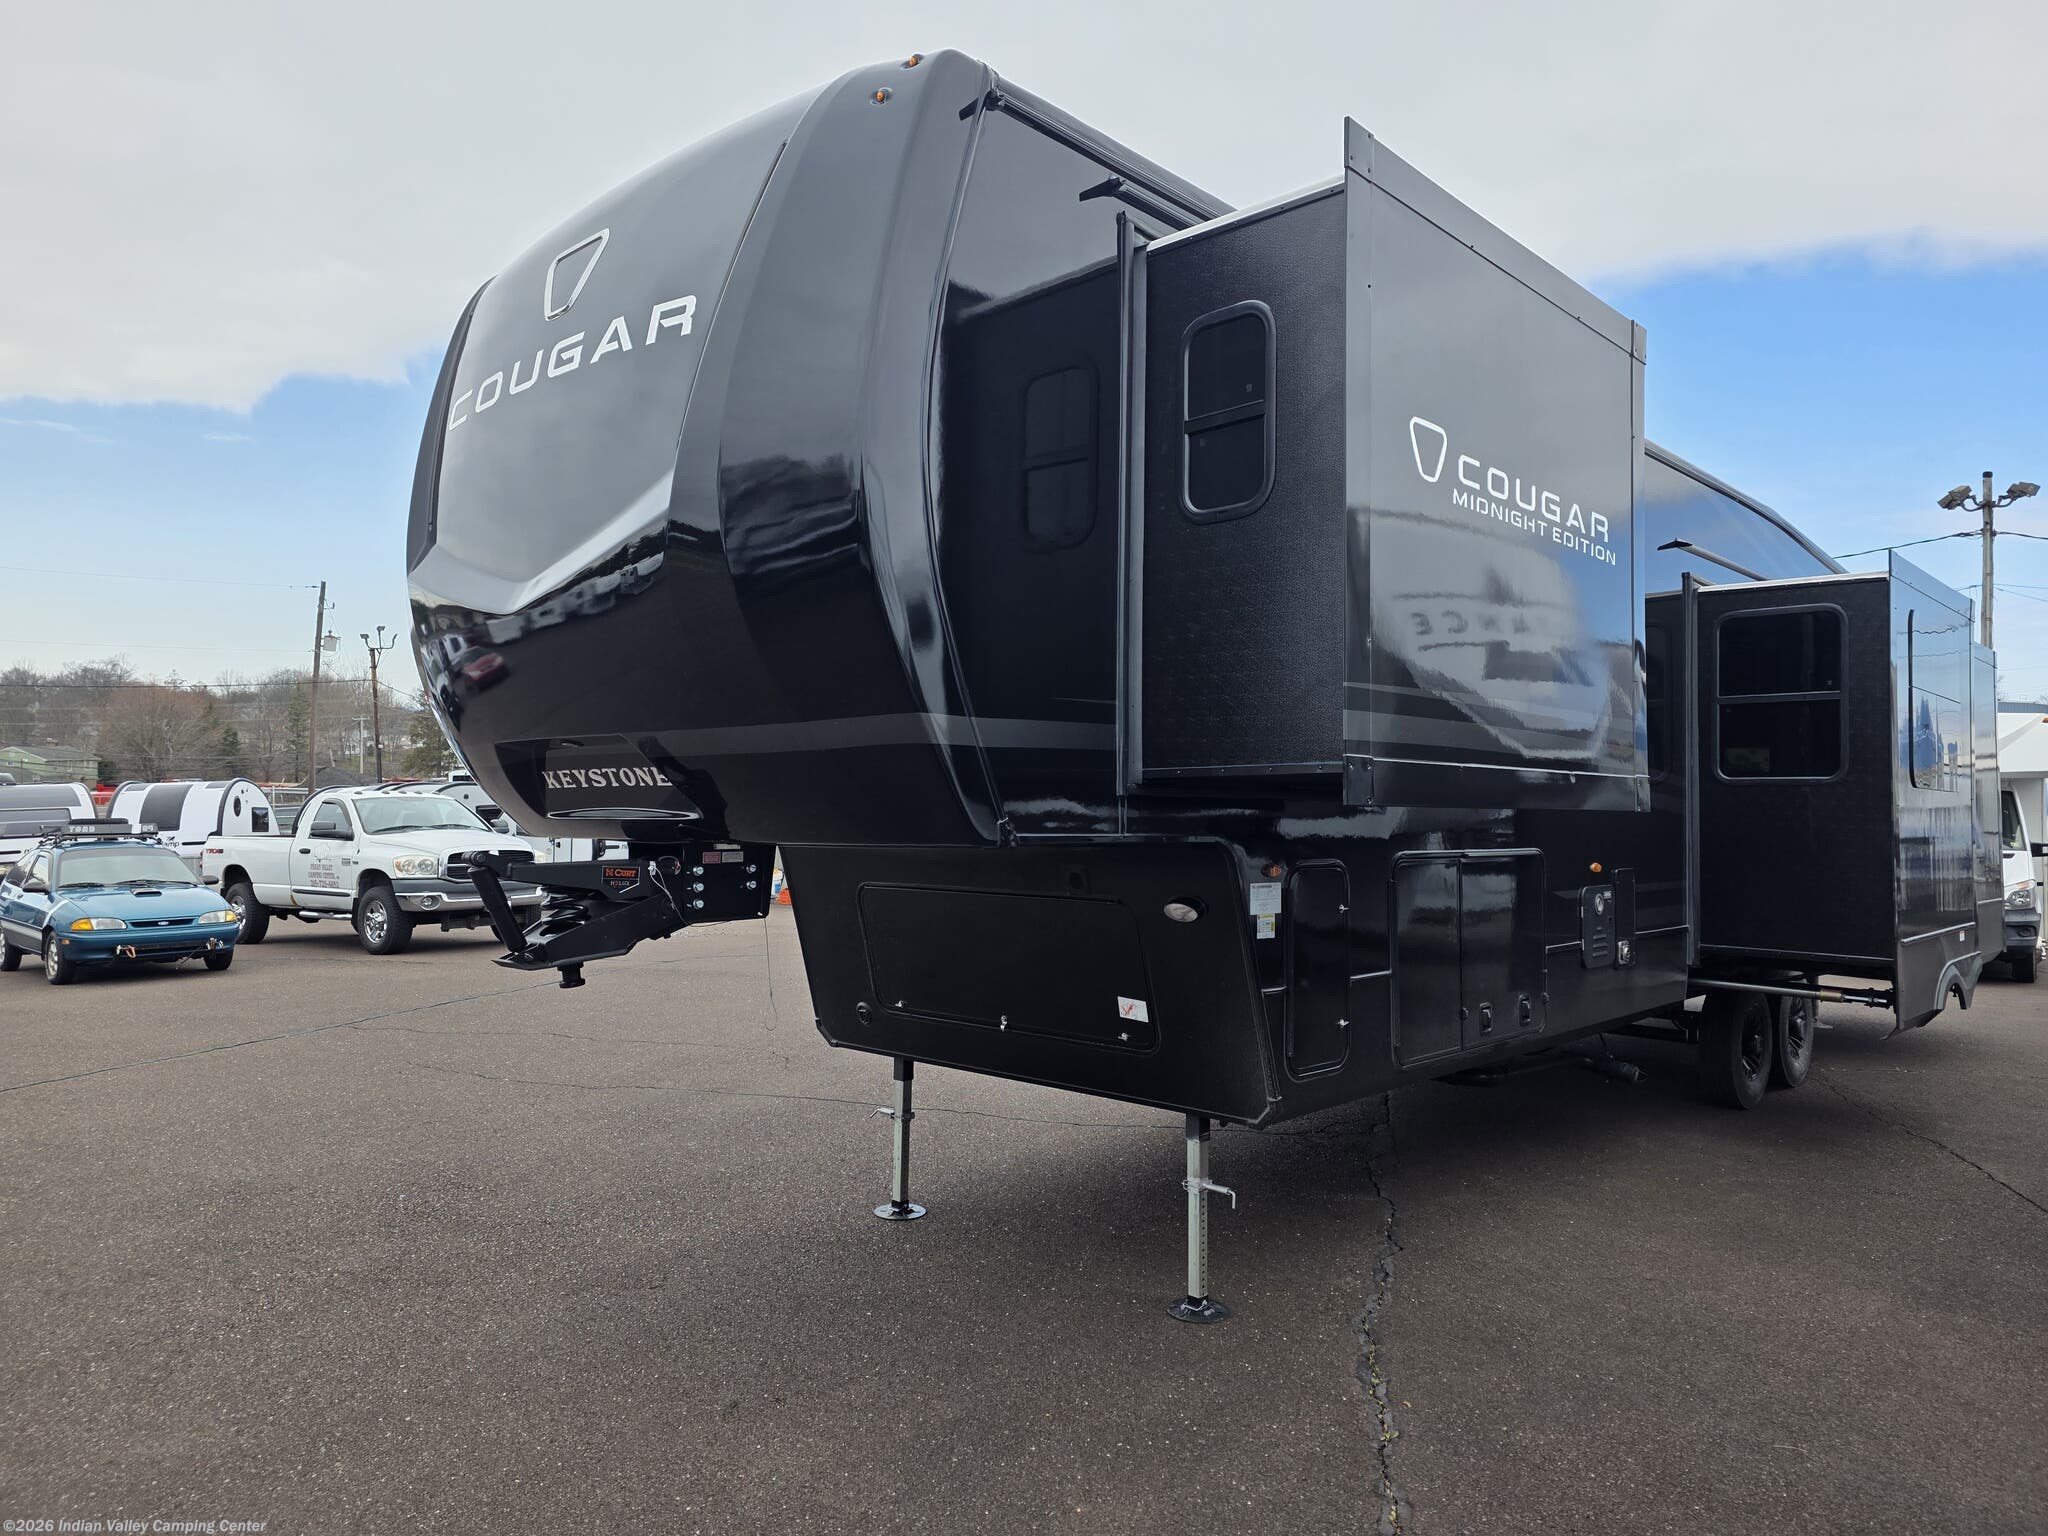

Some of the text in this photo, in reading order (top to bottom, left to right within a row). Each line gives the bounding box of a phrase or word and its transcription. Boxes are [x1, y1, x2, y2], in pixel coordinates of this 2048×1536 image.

[449, 295, 697, 431] COUGAR
[1452, 488, 1616, 566] MIDNIGHT EDITION
[1458, 454, 1609, 543] COUGAR
[542, 766, 673, 789] KEYSTONE
